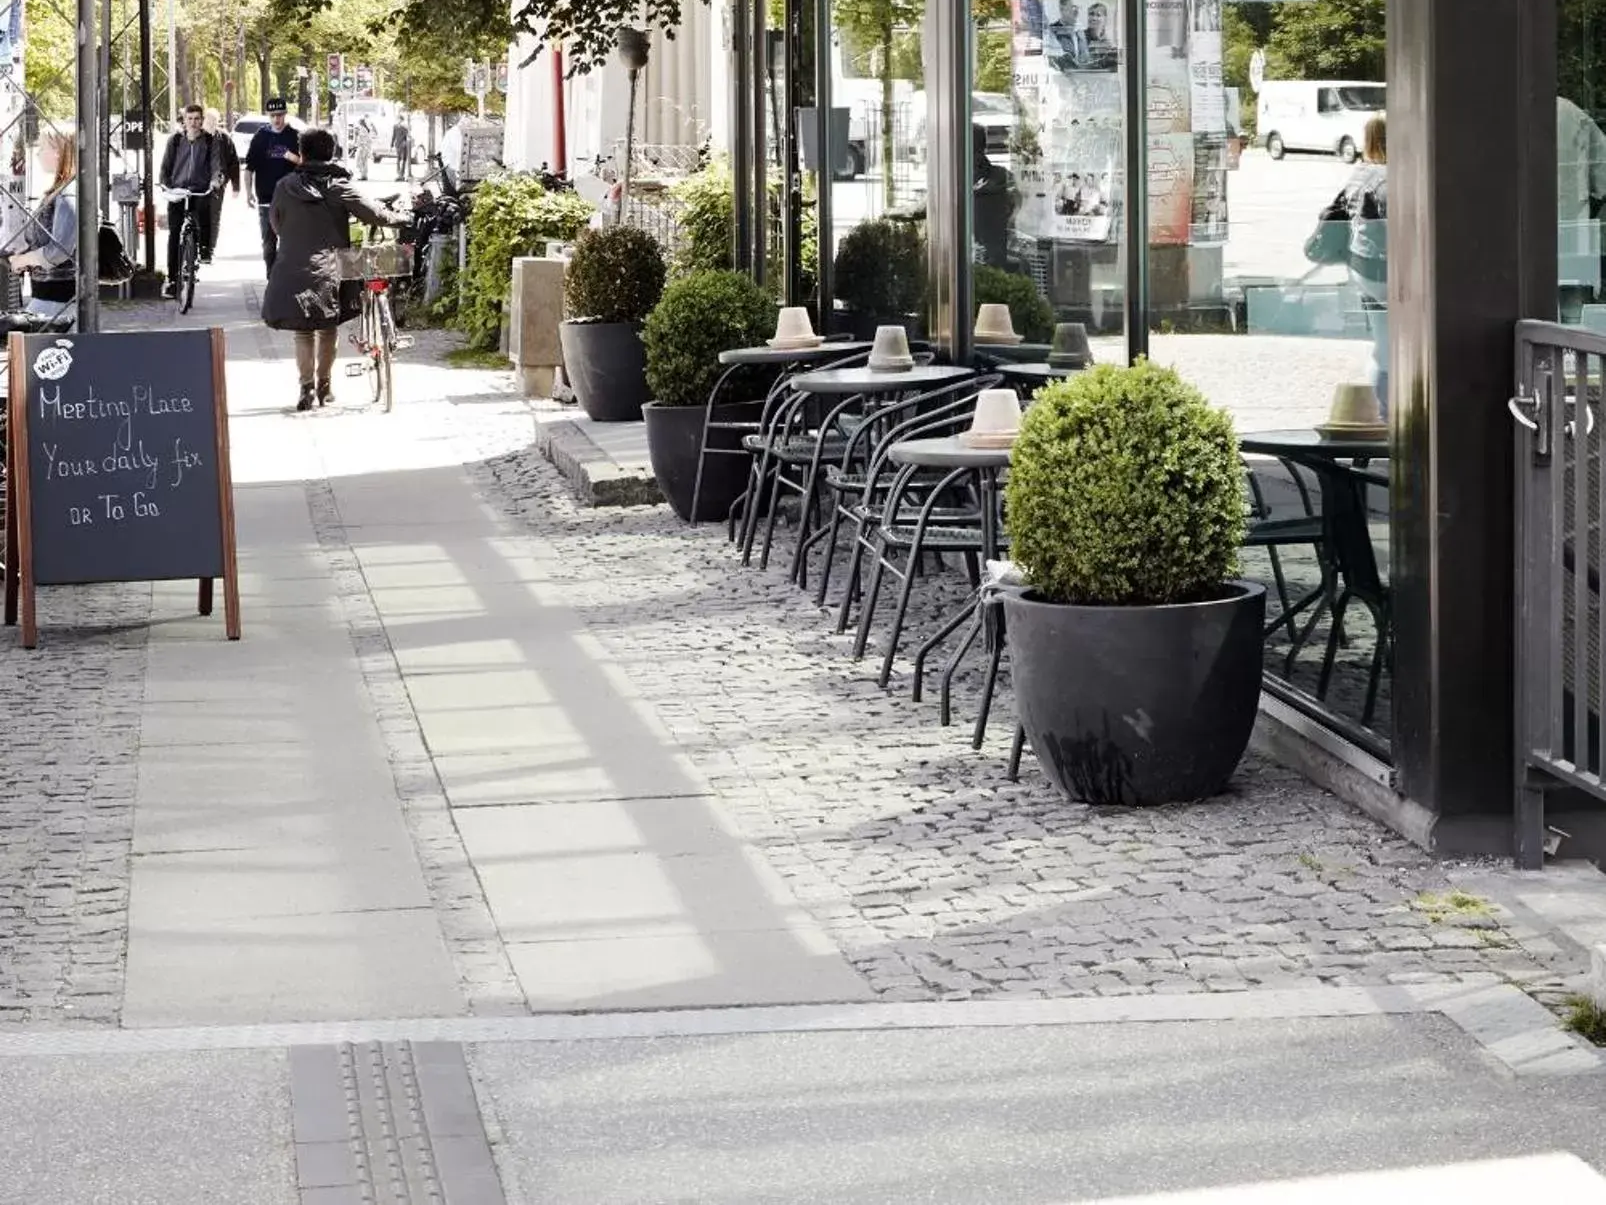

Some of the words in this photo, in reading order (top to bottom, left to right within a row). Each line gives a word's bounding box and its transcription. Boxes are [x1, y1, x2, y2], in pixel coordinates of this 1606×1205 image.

[123, 121, 145, 133] OPE
[38, 351, 69, 374] Wi-Fi
[40, 385, 131, 451] Meeting
[102, 440, 158, 489] daily
[98, 494, 125, 520] To
[133, 491, 160, 516] Go
